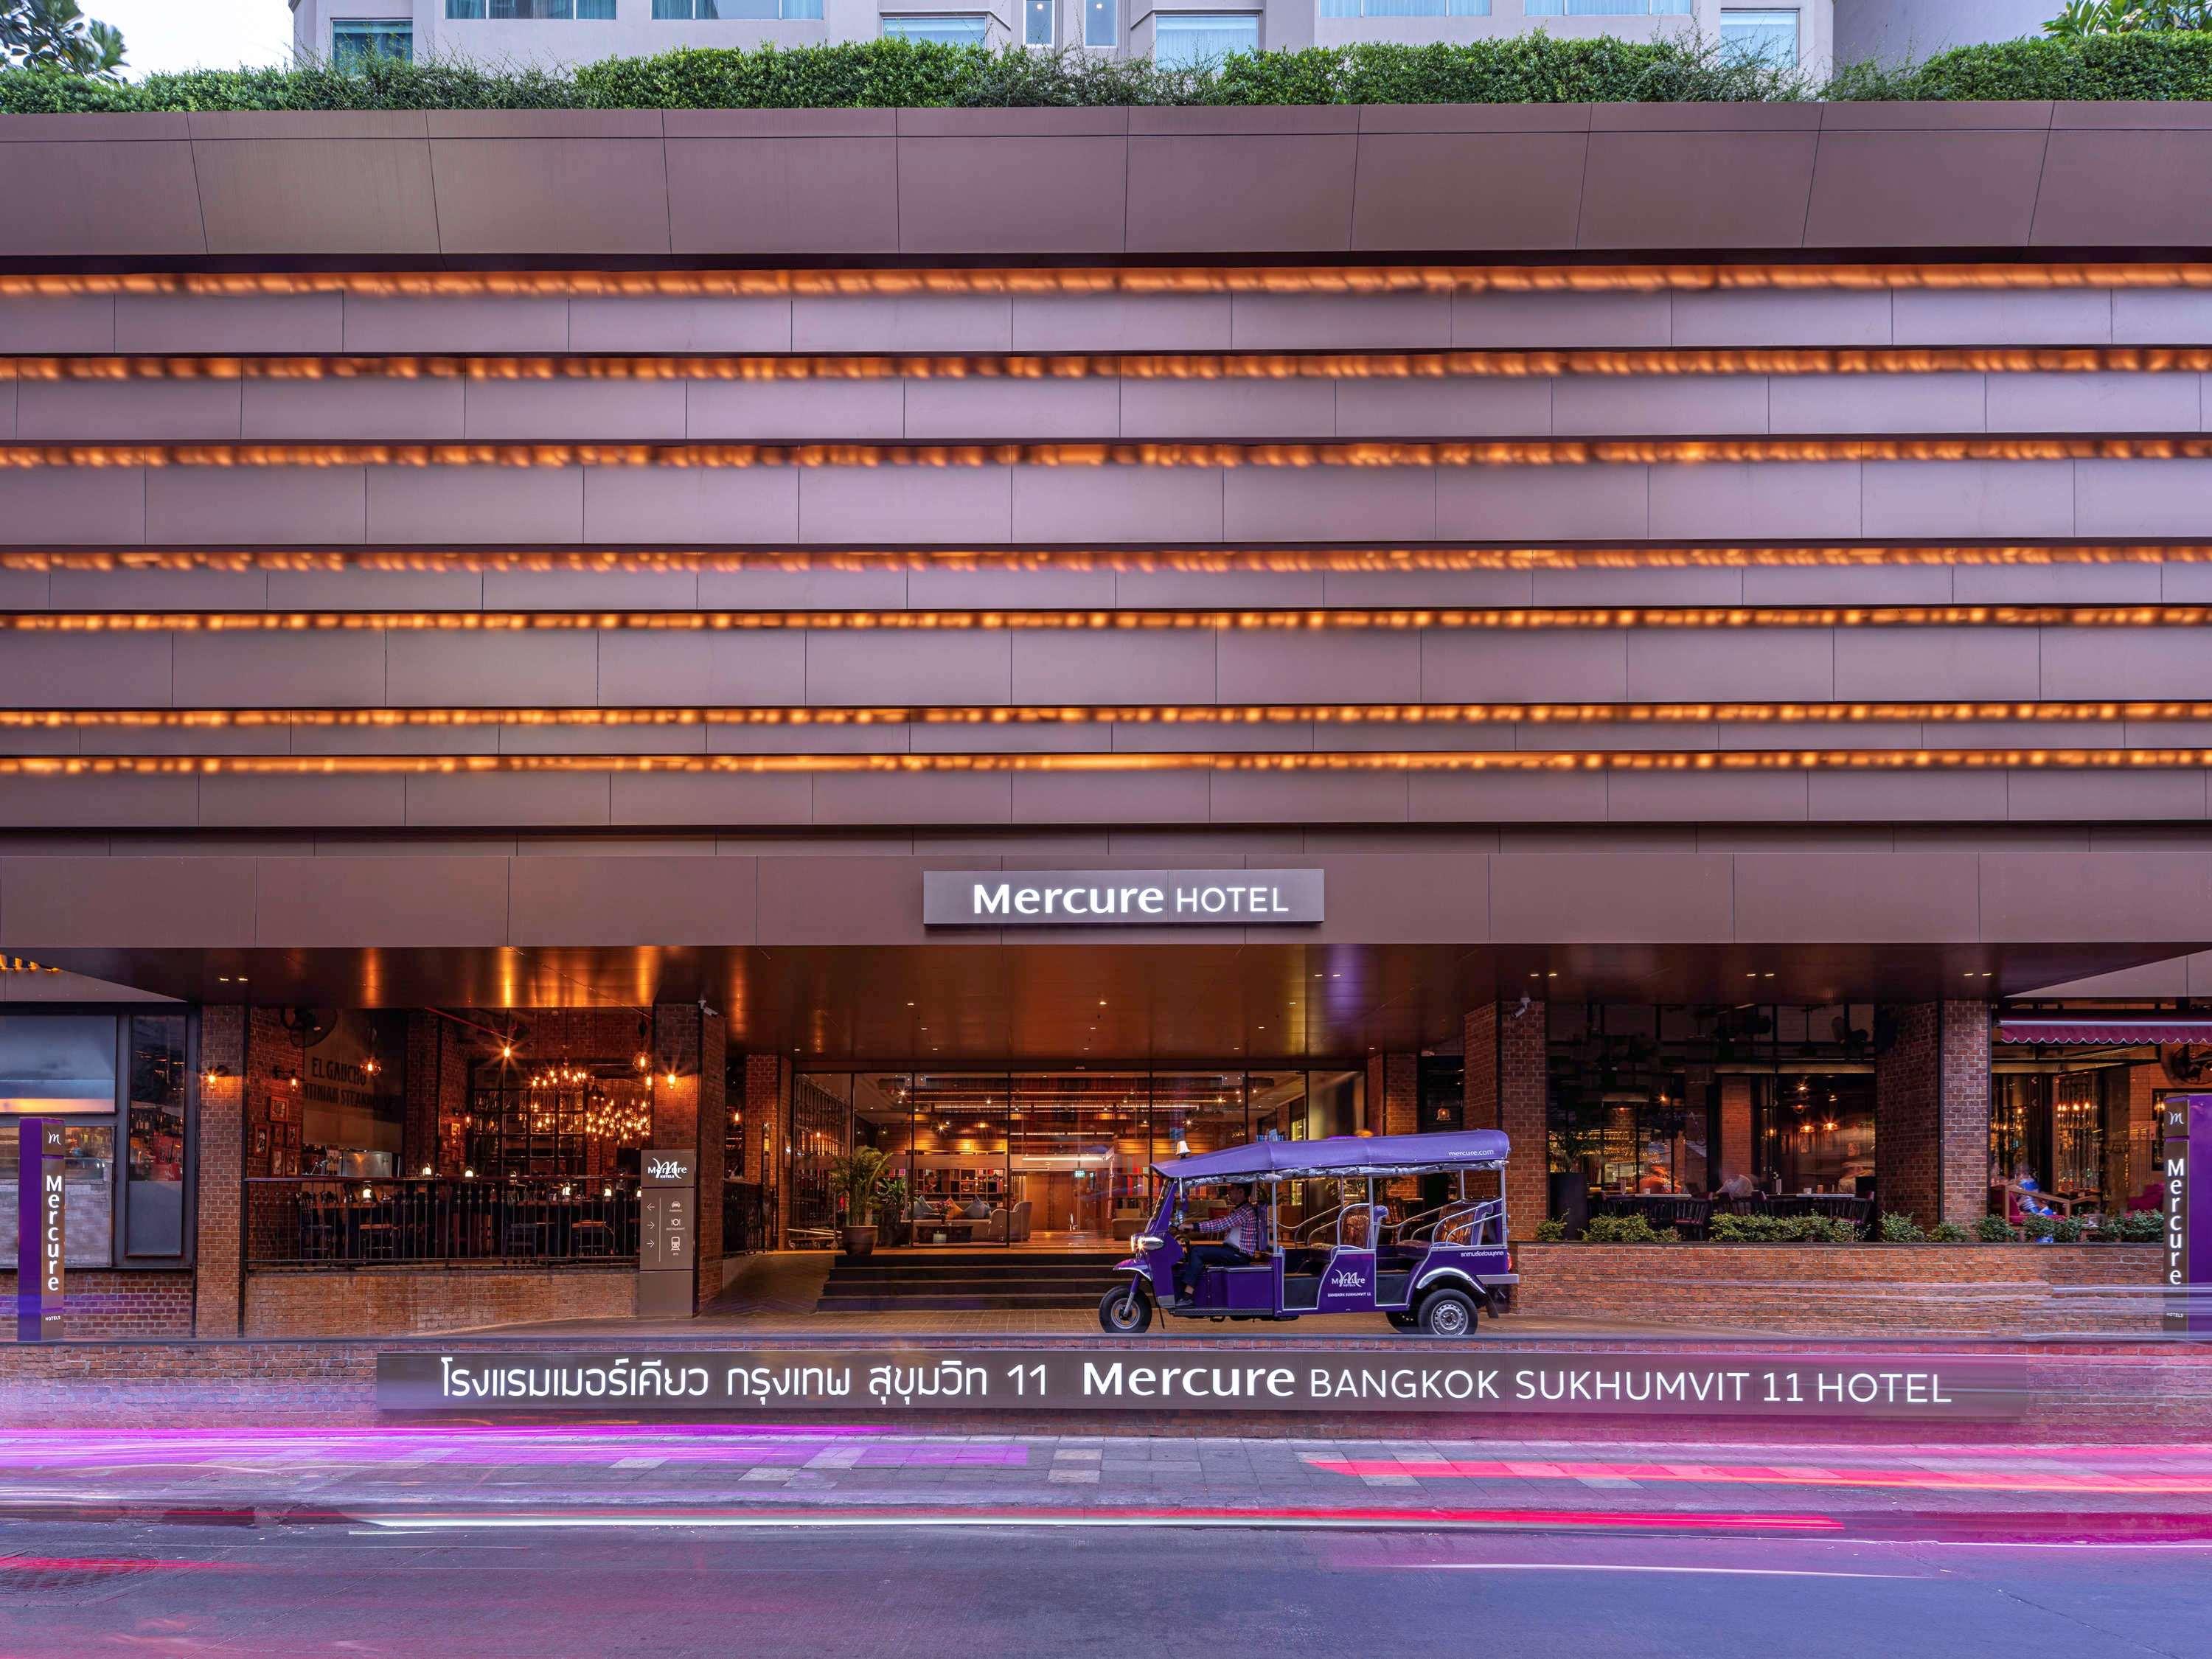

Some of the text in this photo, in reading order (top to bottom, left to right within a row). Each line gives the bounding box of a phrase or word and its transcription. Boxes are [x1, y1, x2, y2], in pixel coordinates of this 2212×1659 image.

[973, 884, 1289, 914] Mercure HOTEL
[46, 1175, 62, 1291] Mercure
[2167, 1158, 2185, 1285] Mercure
[440, 1357, 1046, 1405] โรงแรมเมอร์เคียว กรุงเทพ สุขุมวิท 11
[1083, 1362, 1952, 1403] Mercure BANGKOK SUKHUMVIT 11 HOTEL
